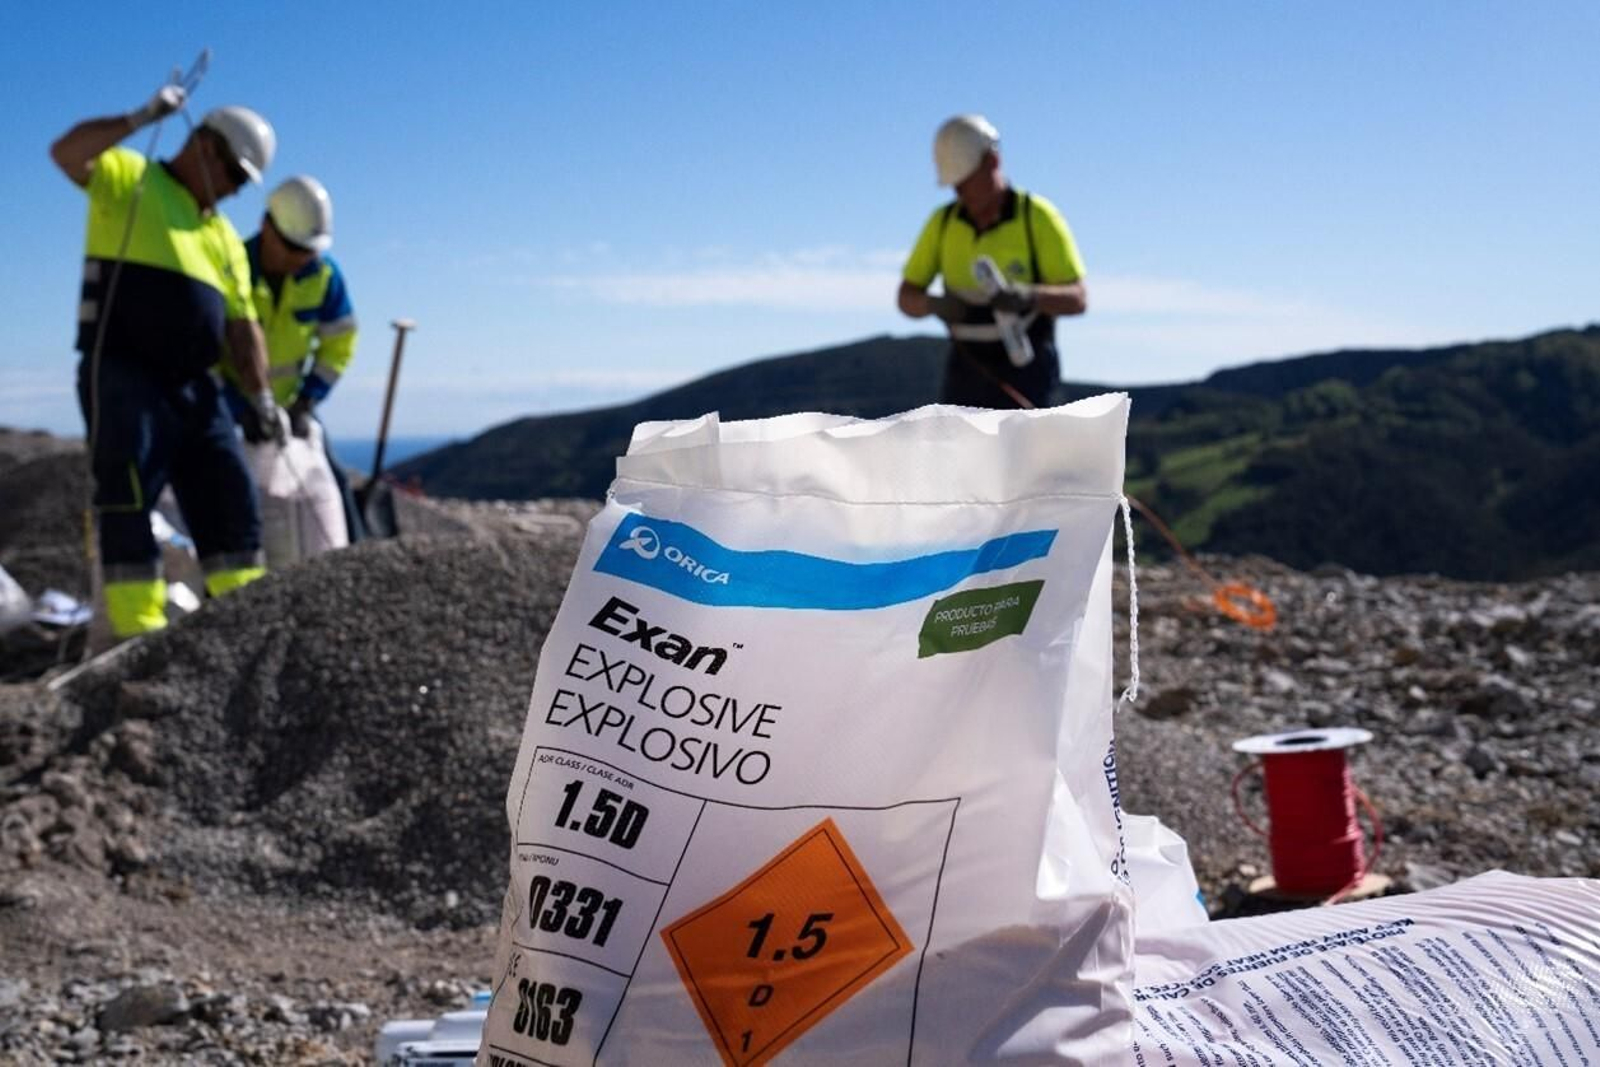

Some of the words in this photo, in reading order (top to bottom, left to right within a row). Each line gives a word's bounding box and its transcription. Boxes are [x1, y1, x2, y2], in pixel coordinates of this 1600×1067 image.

[664, 546, 730, 585] ORICA
[934, 604, 992, 623] PRODUCTO
[588, 596, 728, 675] Exan
[565, 643, 782, 738] EXPLOSIVE
[545, 688, 771, 785] EXPLOSIVO
[538, 754, 553, 764] ADR
[554, 756, 581, 770] CLASS
[586, 764, 613, 781] CLASE
[614, 776, 634, 790] ADR
[554, 779, 650, 849] 1.5D
[529, 875, 623, 947] 0331
[746, 913, 835, 961] 1.5
[1217, 954, 1287, 977] FUENTES
[1226, 952, 1267, 965] HEAT
[748, 984, 774, 1007] D
[741, 1030, 753, 1053] 1
